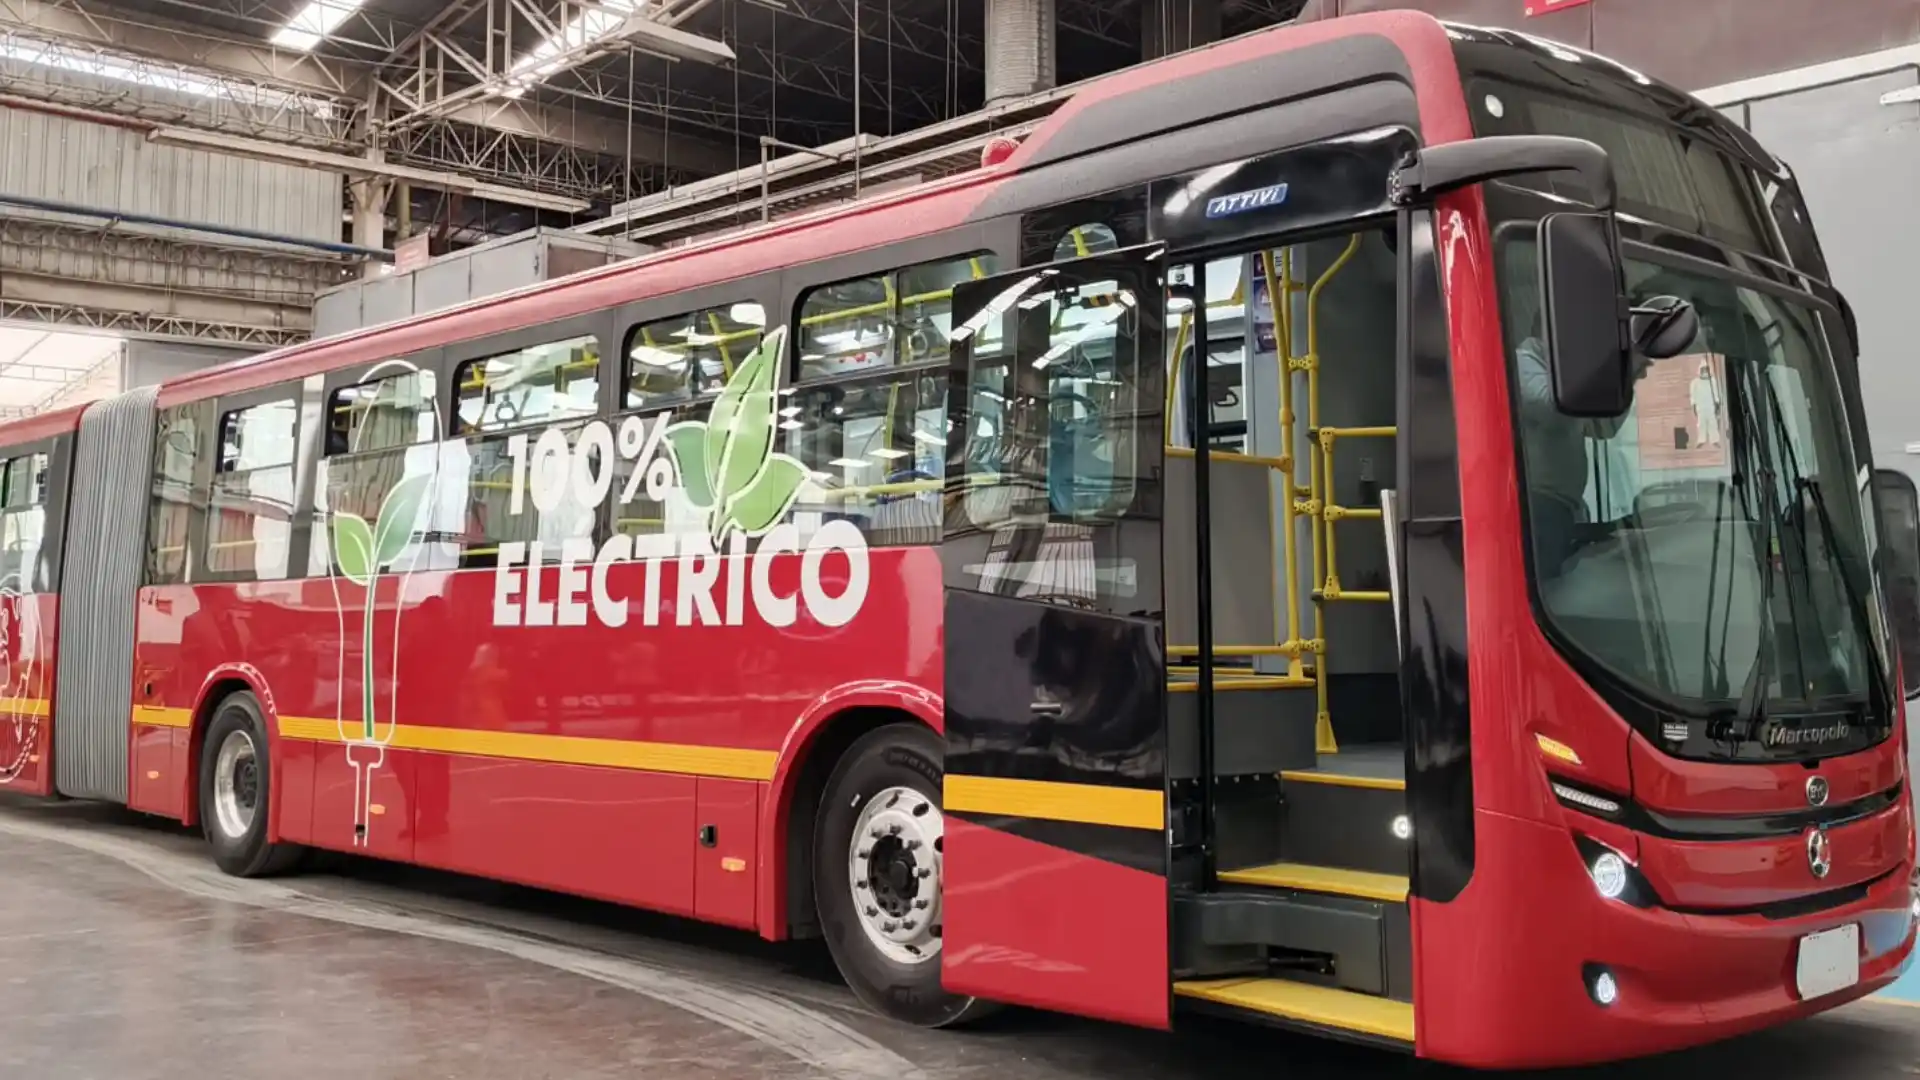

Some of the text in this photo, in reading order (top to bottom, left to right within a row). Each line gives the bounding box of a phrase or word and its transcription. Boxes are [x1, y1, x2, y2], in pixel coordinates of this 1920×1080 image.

[1213, 186, 1280, 214] ATTIVI
[508, 411, 675, 515] 100%
[493, 519, 870, 628] ELECTRICO
[1769, 719, 1849, 745] Marcopolo
